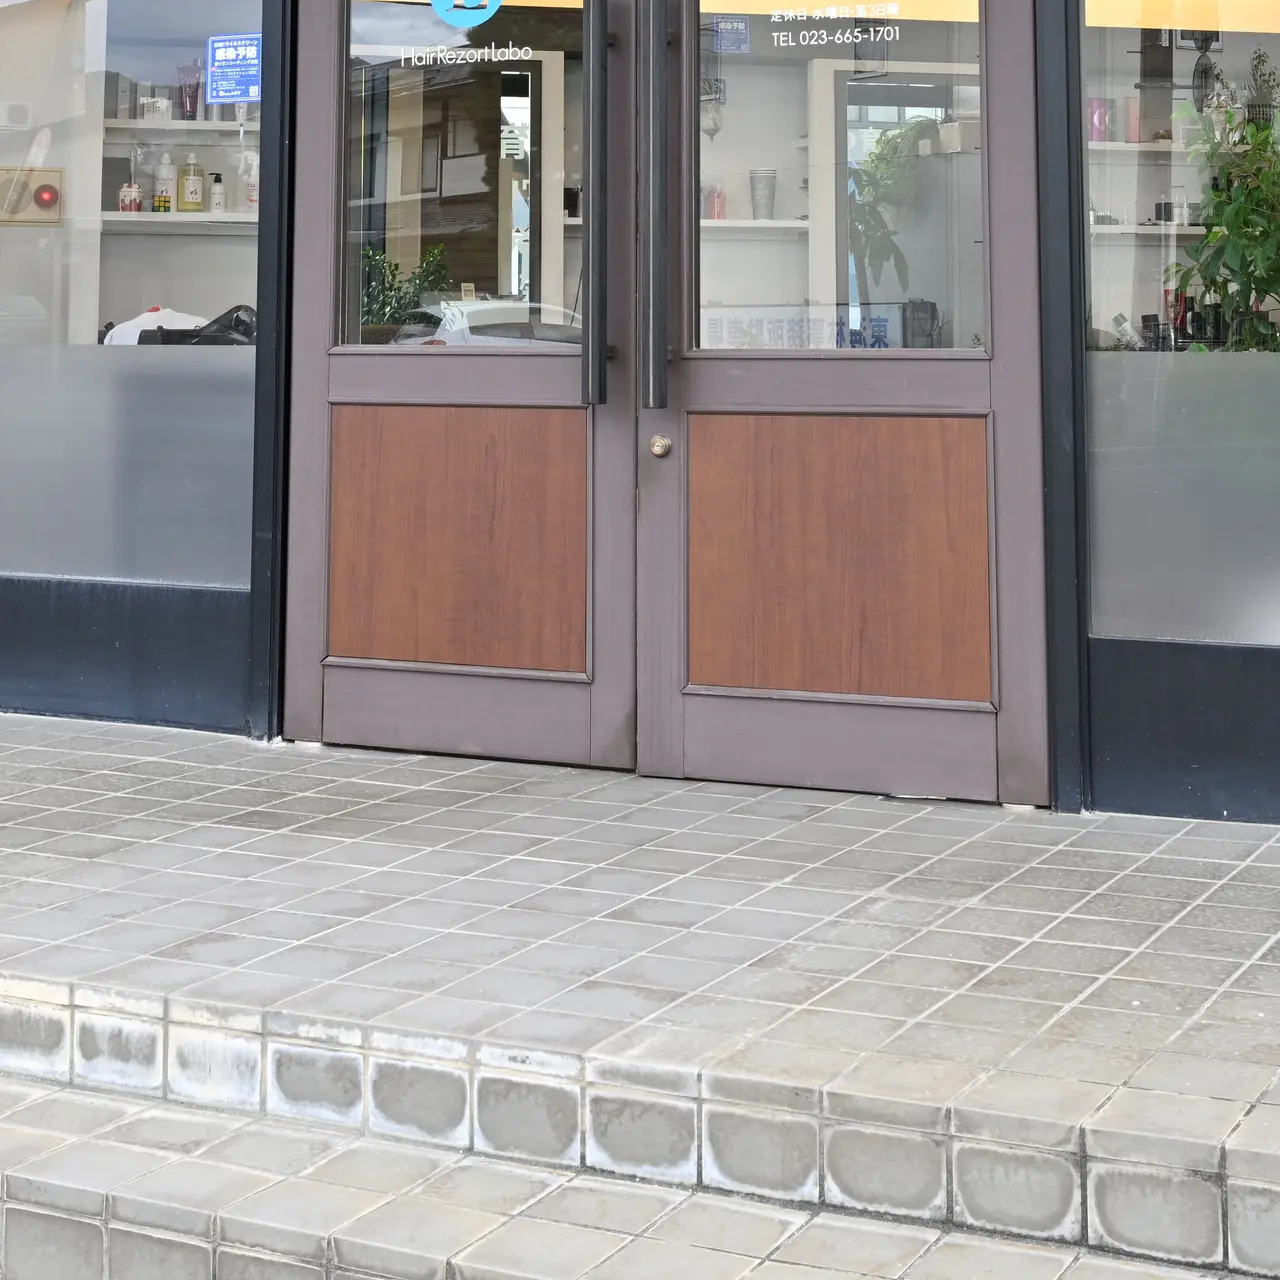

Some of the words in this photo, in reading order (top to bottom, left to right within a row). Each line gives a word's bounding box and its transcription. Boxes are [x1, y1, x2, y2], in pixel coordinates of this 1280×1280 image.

[770, 8, 807, 23] 定休日
[772, 32, 796, 47] TEL
[799, 26, 900, 46] 023-665-1701
[215, 45, 258, 60] 感染予防
